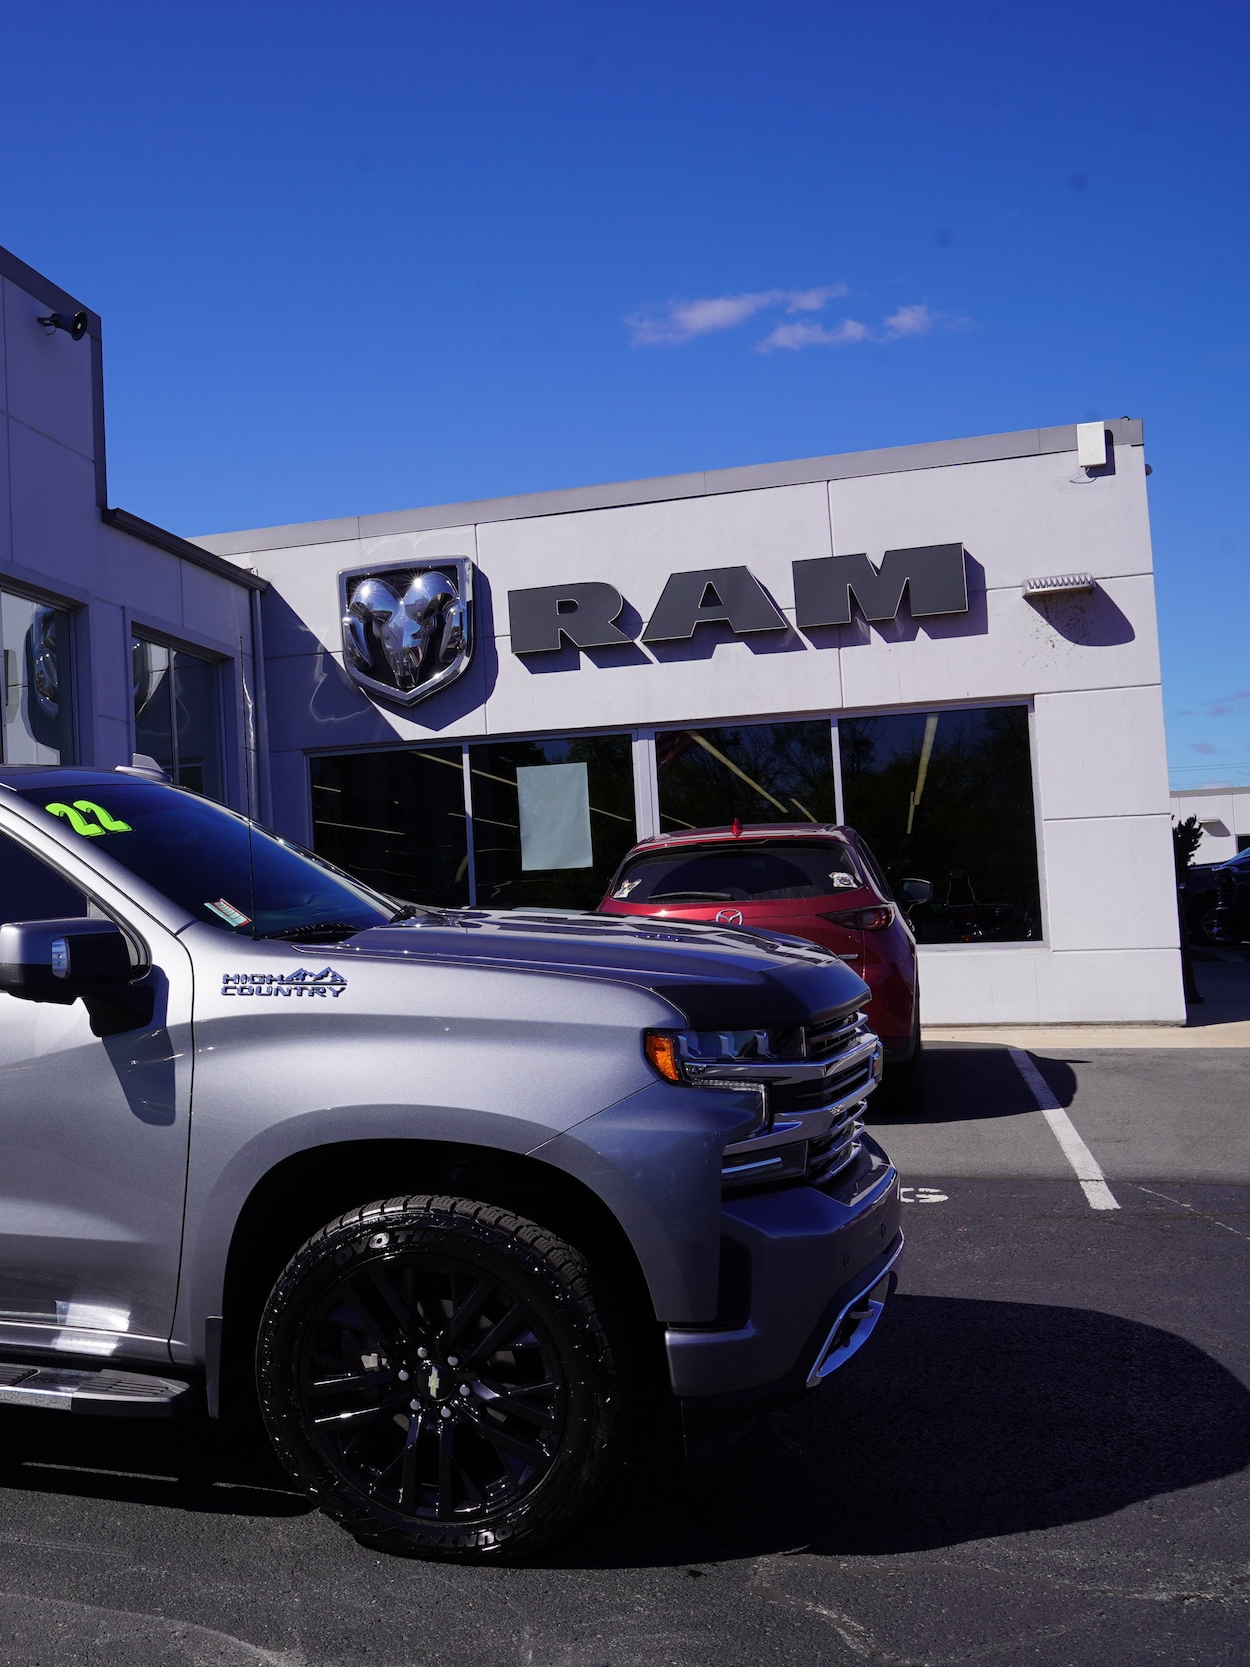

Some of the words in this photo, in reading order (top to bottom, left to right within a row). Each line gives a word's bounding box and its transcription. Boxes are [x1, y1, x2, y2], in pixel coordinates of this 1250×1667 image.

[508, 542, 968, 654] RAM
[44, 799, 133, 837] 22
[220, 985, 348, 998] COUNTRY
[221, 973, 287, 985] HIGH
